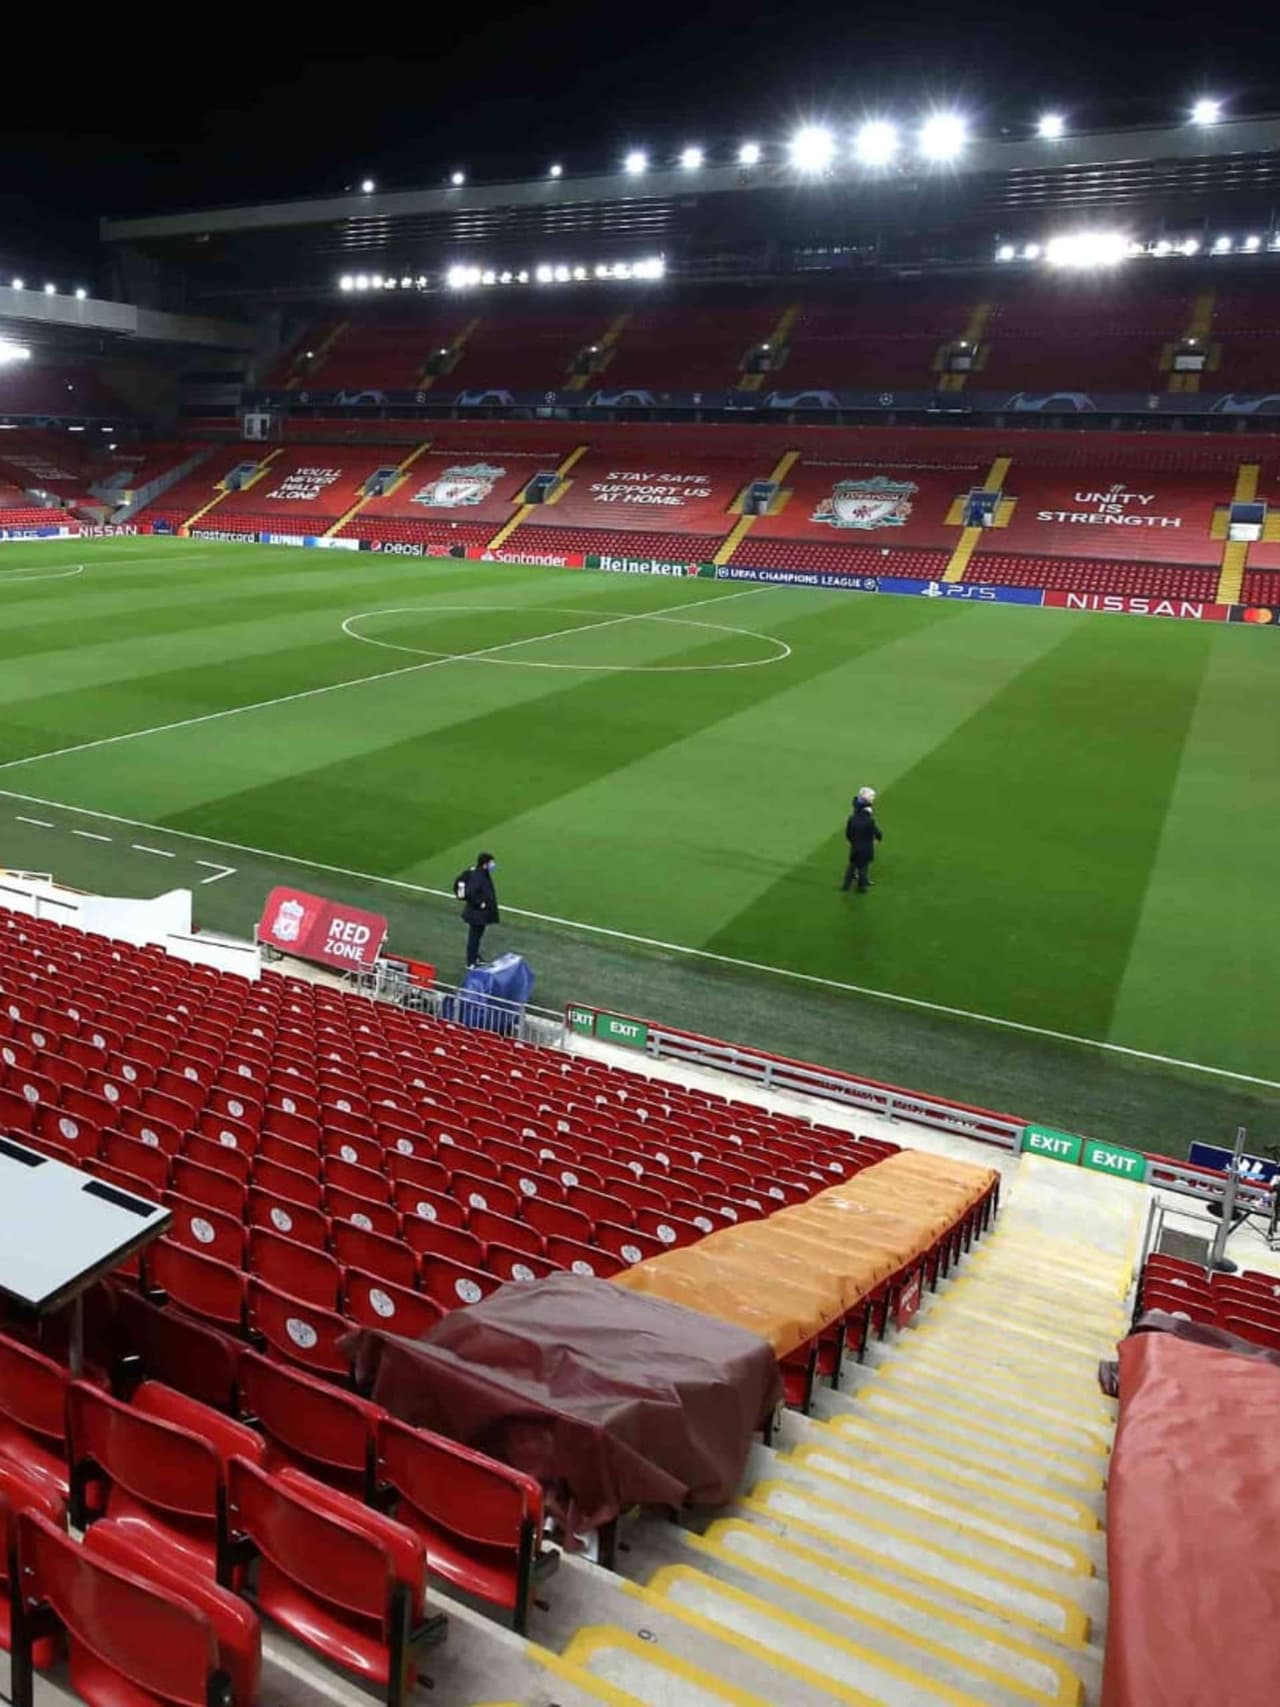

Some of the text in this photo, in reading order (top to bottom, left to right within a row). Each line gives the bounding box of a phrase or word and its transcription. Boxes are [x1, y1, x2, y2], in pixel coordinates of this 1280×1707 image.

[605, 472, 655, 481] STAY
[588, 483, 712, 497] SUPPORT US
[593, 493, 621, 502] AT
[1074, 492, 1155, 505] UNITY
[1099, 503, 1123, 514] IS
[1037, 511, 1181, 528] STRENGTH
[80, 525, 137, 537] NISSAN
[191, 529, 255, 544] mastercard
[495, 550, 568, 568] Santander
[600, 556, 683, 577] Heineken
[731, 568, 861, 587] UEFA CHAMPIONS LEAGUE
[947, 585, 996, 600] PS5
[1066, 593, 1203, 618] NISSAN
[328, 917, 371, 946] RED
[323, 937, 366, 961] ZONE
[568, 1010, 594, 1026] EXIT
[610, 1021, 640, 1038] EXIT
[1029, 1133, 1073, 1156] EXIT
[1091, 1150, 1137, 1173] EXIT
